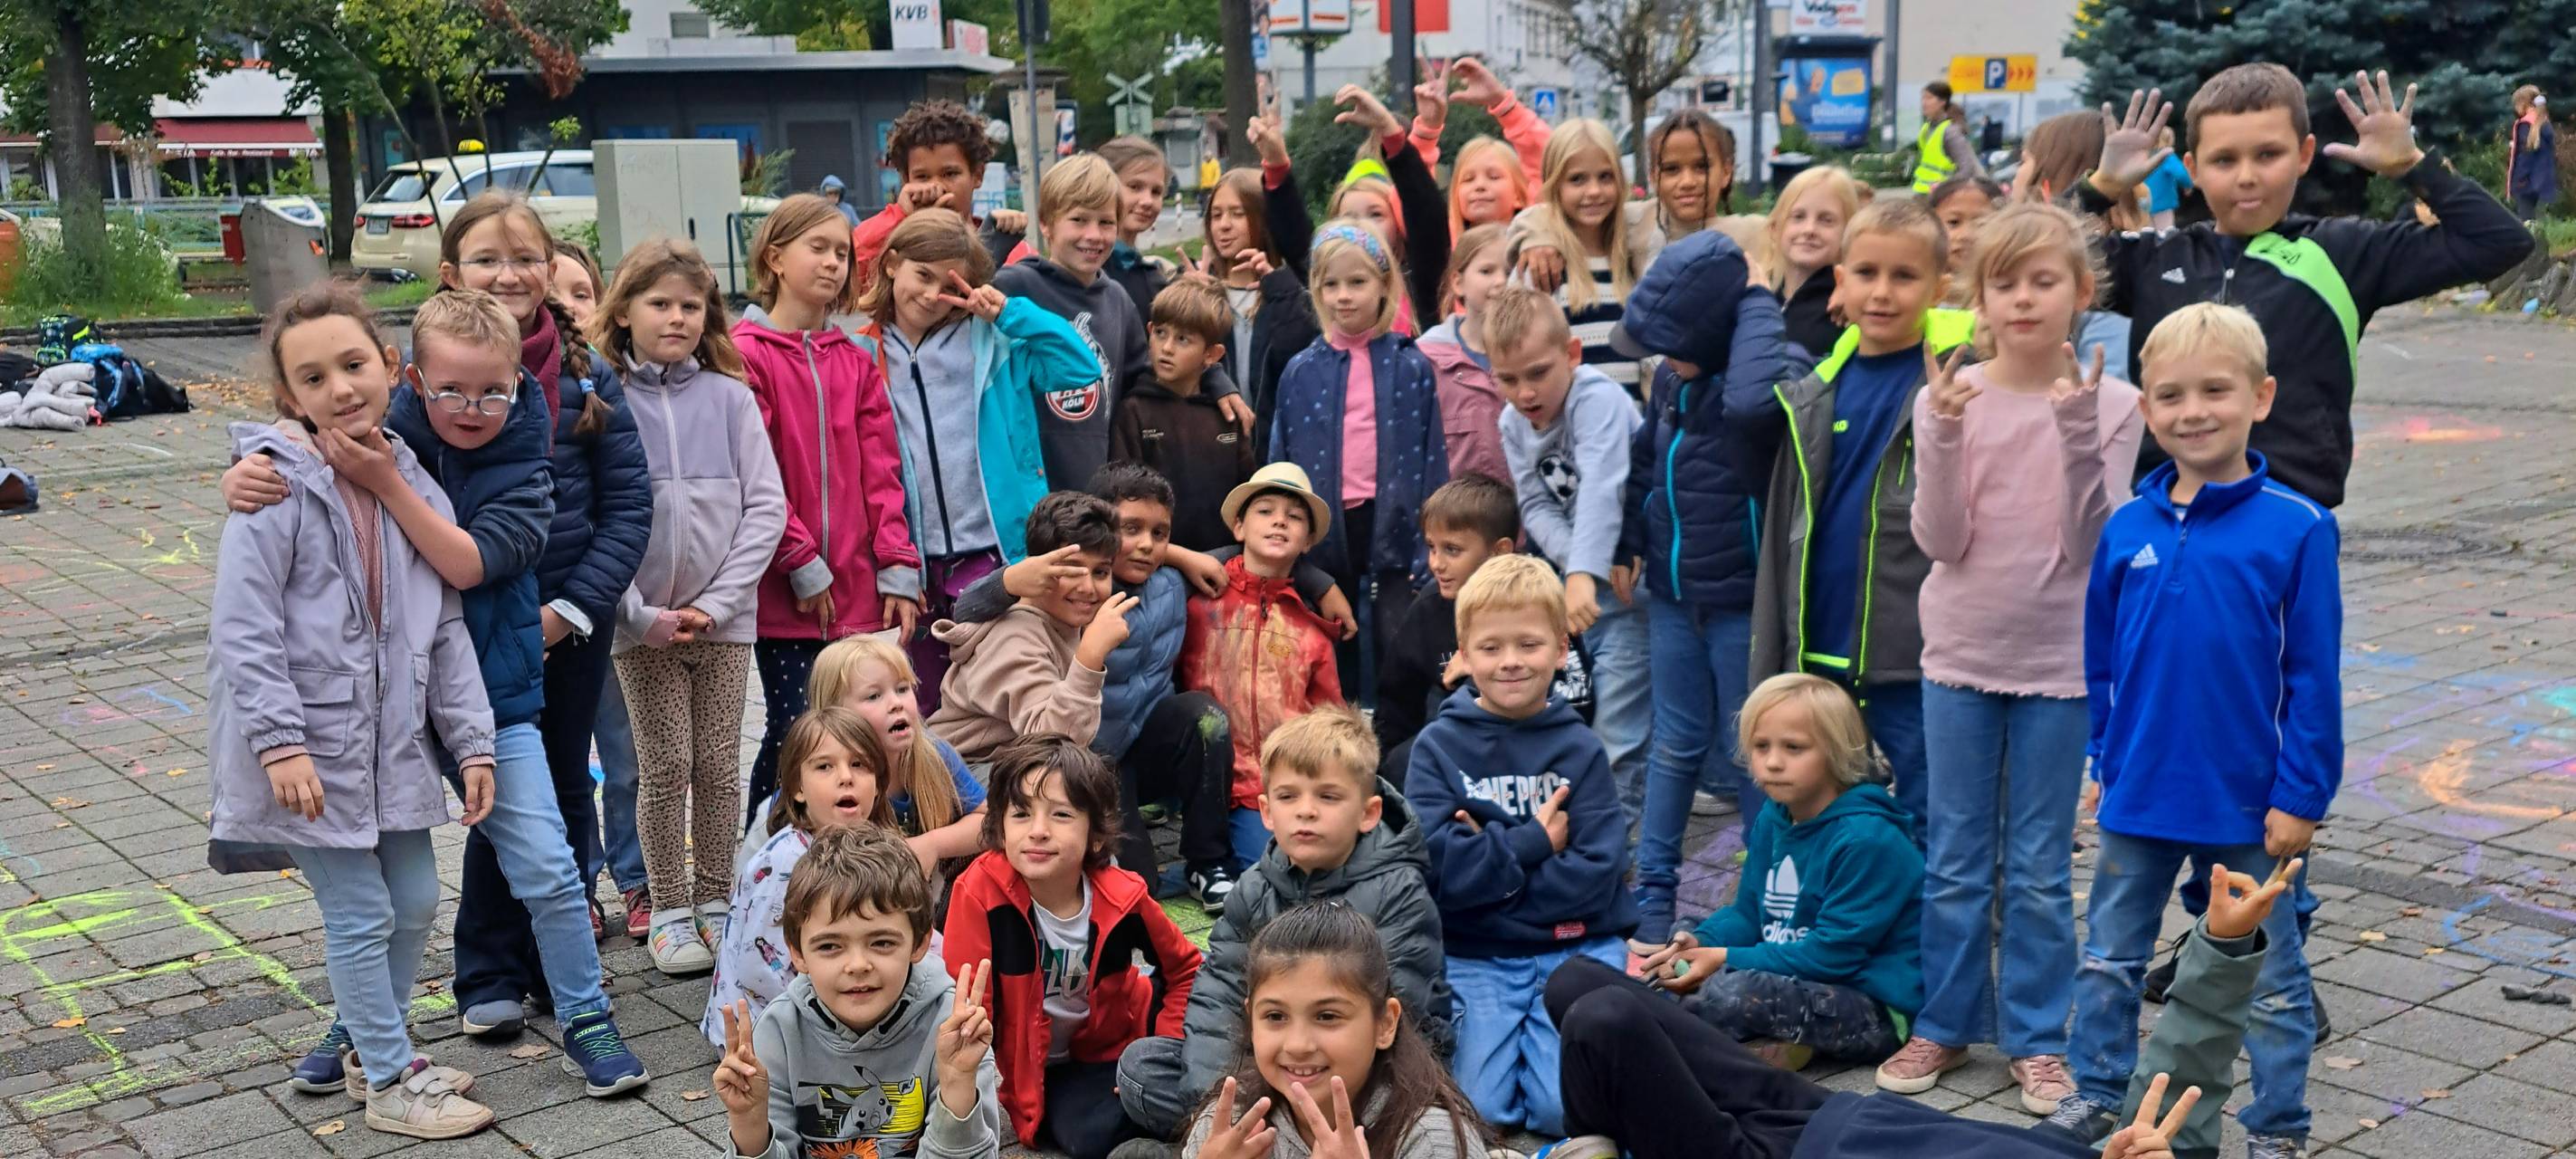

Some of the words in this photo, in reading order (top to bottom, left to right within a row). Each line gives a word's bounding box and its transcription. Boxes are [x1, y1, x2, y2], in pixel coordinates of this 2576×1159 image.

[895, 5, 928, 20] KVB
[1989, 61, 2004, 87] P
[1062, 396, 1085, 409] KÖLN
